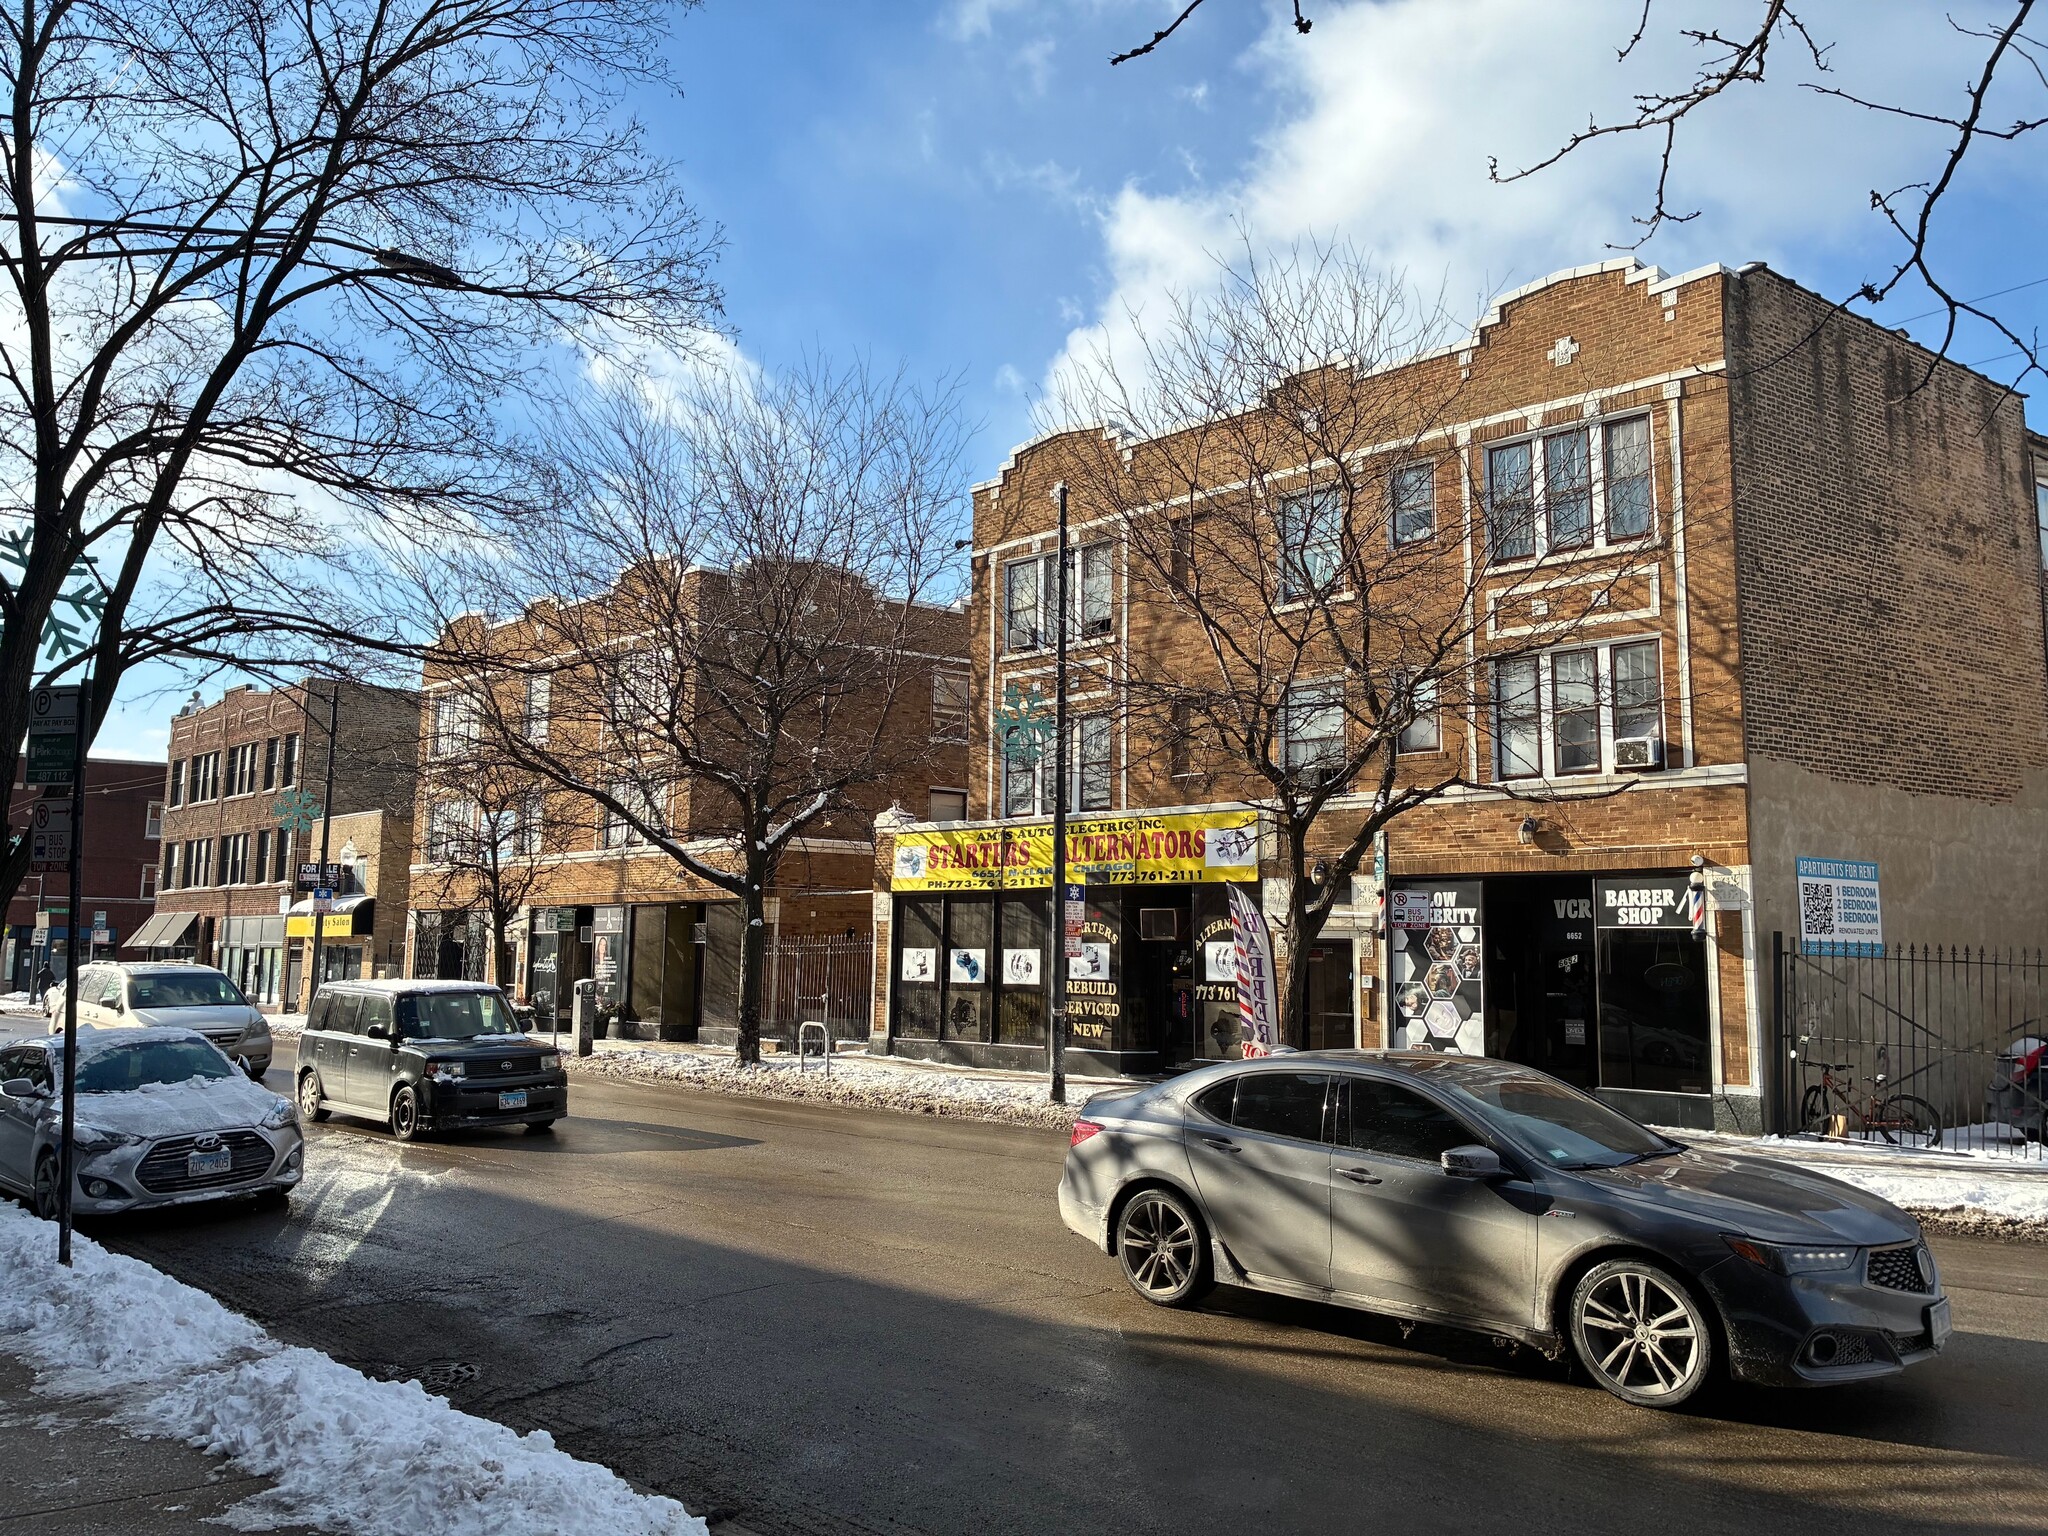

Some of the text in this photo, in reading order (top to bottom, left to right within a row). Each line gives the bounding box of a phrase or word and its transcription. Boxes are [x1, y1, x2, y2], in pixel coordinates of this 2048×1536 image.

[54, 771, 68, 780] 112
[1138, 819, 1165, 831] INC.
[48, 834, 64, 845] BUS
[48, 847, 67, 859] STOP
[928, 829, 1206, 869] STARTERS ALTERNATORS
[33, 862, 68, 871] TOW ZONE
[301, 864, 317, 873] FOR
[971, 870, 1001, 878] 6652
[1073, 862, 1134, 873] CHICAGO
[1800, 860, 1875, 879] APARTMENTS FOR RENT
[1111, 869, 1203, 882] 773-761-2111
[1605, 889, 1676, 907] BARBER
[1836, 886, 1877, 898] 1 BEDROOM
[1553, 899, 1592, 919] VCR
[1837, 899, 1878, 911] 2 BEDROOM
[332, 917, 350, 926] Salon
[1618, 907, 1663, 925] SHOP
[1838, 912, 1879, 924] 3 BEDROOM
[1839, 927, 1865, 935] RENOVATED
[1066, 980, 1117, 996] REBUILD
[1073, 1022, 1104, 1038] NEW
[210, 1158, 228, 1169] 2405
